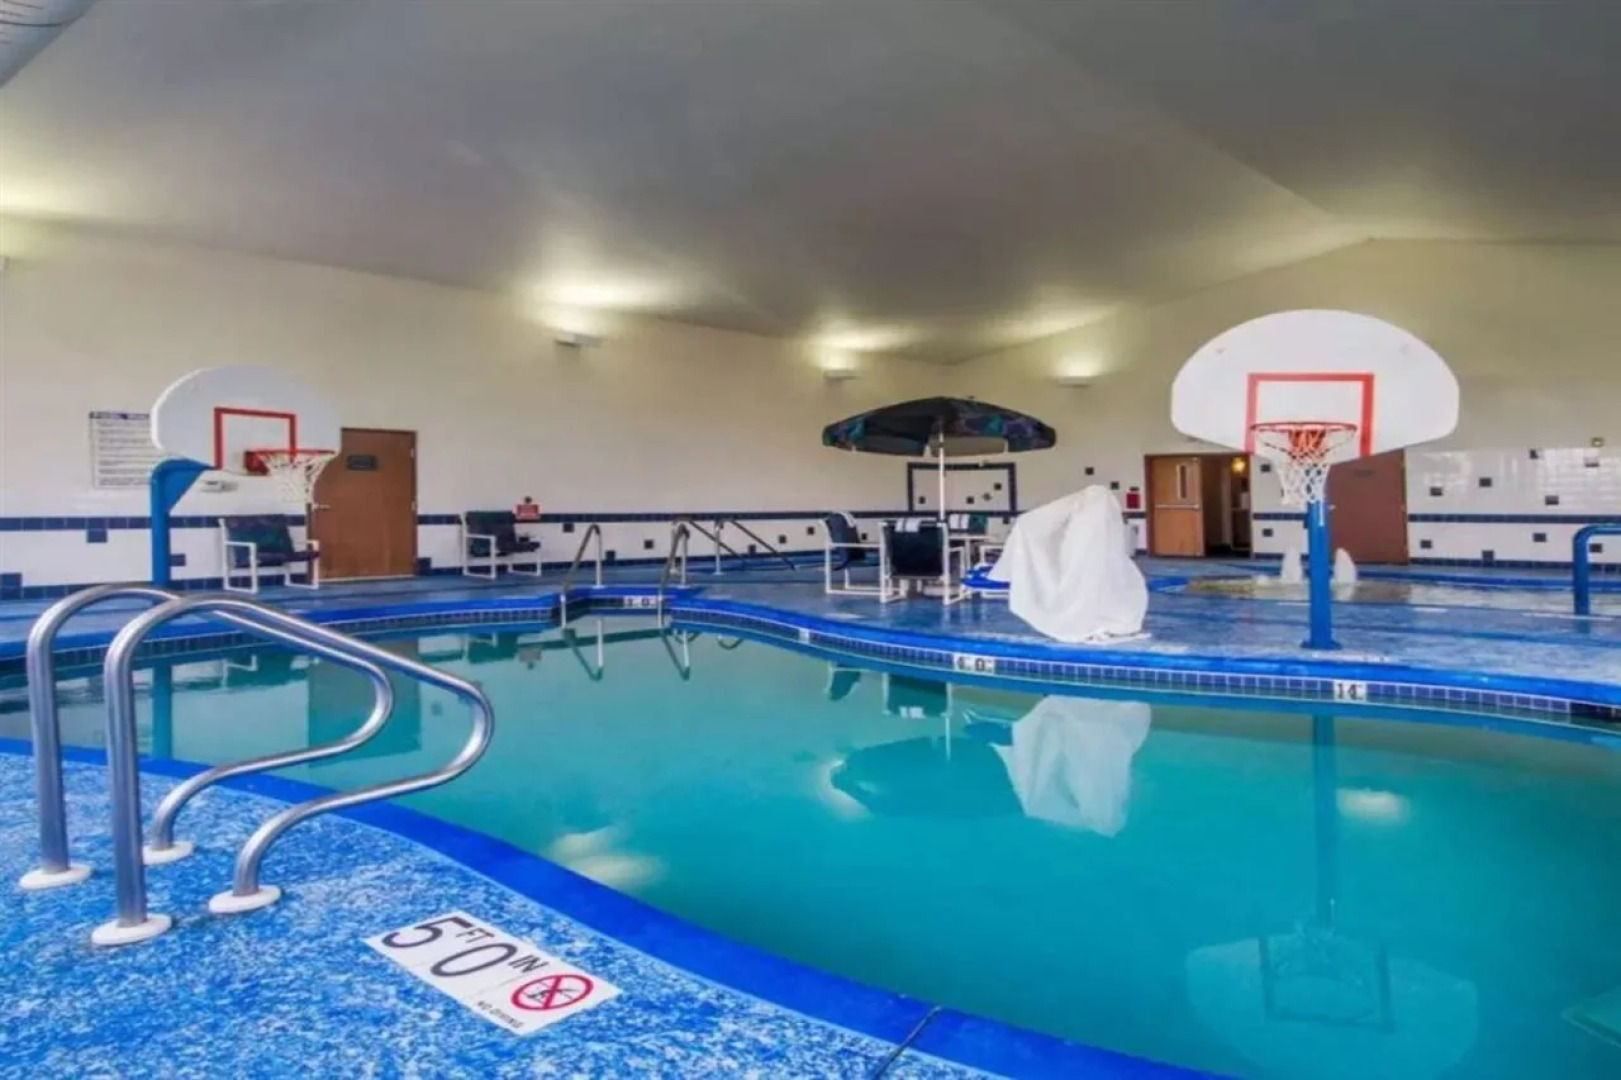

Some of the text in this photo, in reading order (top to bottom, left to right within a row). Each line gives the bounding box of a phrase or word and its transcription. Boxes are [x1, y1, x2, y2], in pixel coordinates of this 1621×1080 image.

[381, 916, 495, 949] 5 FT
[429, 942, 548, 977] 0 IN
